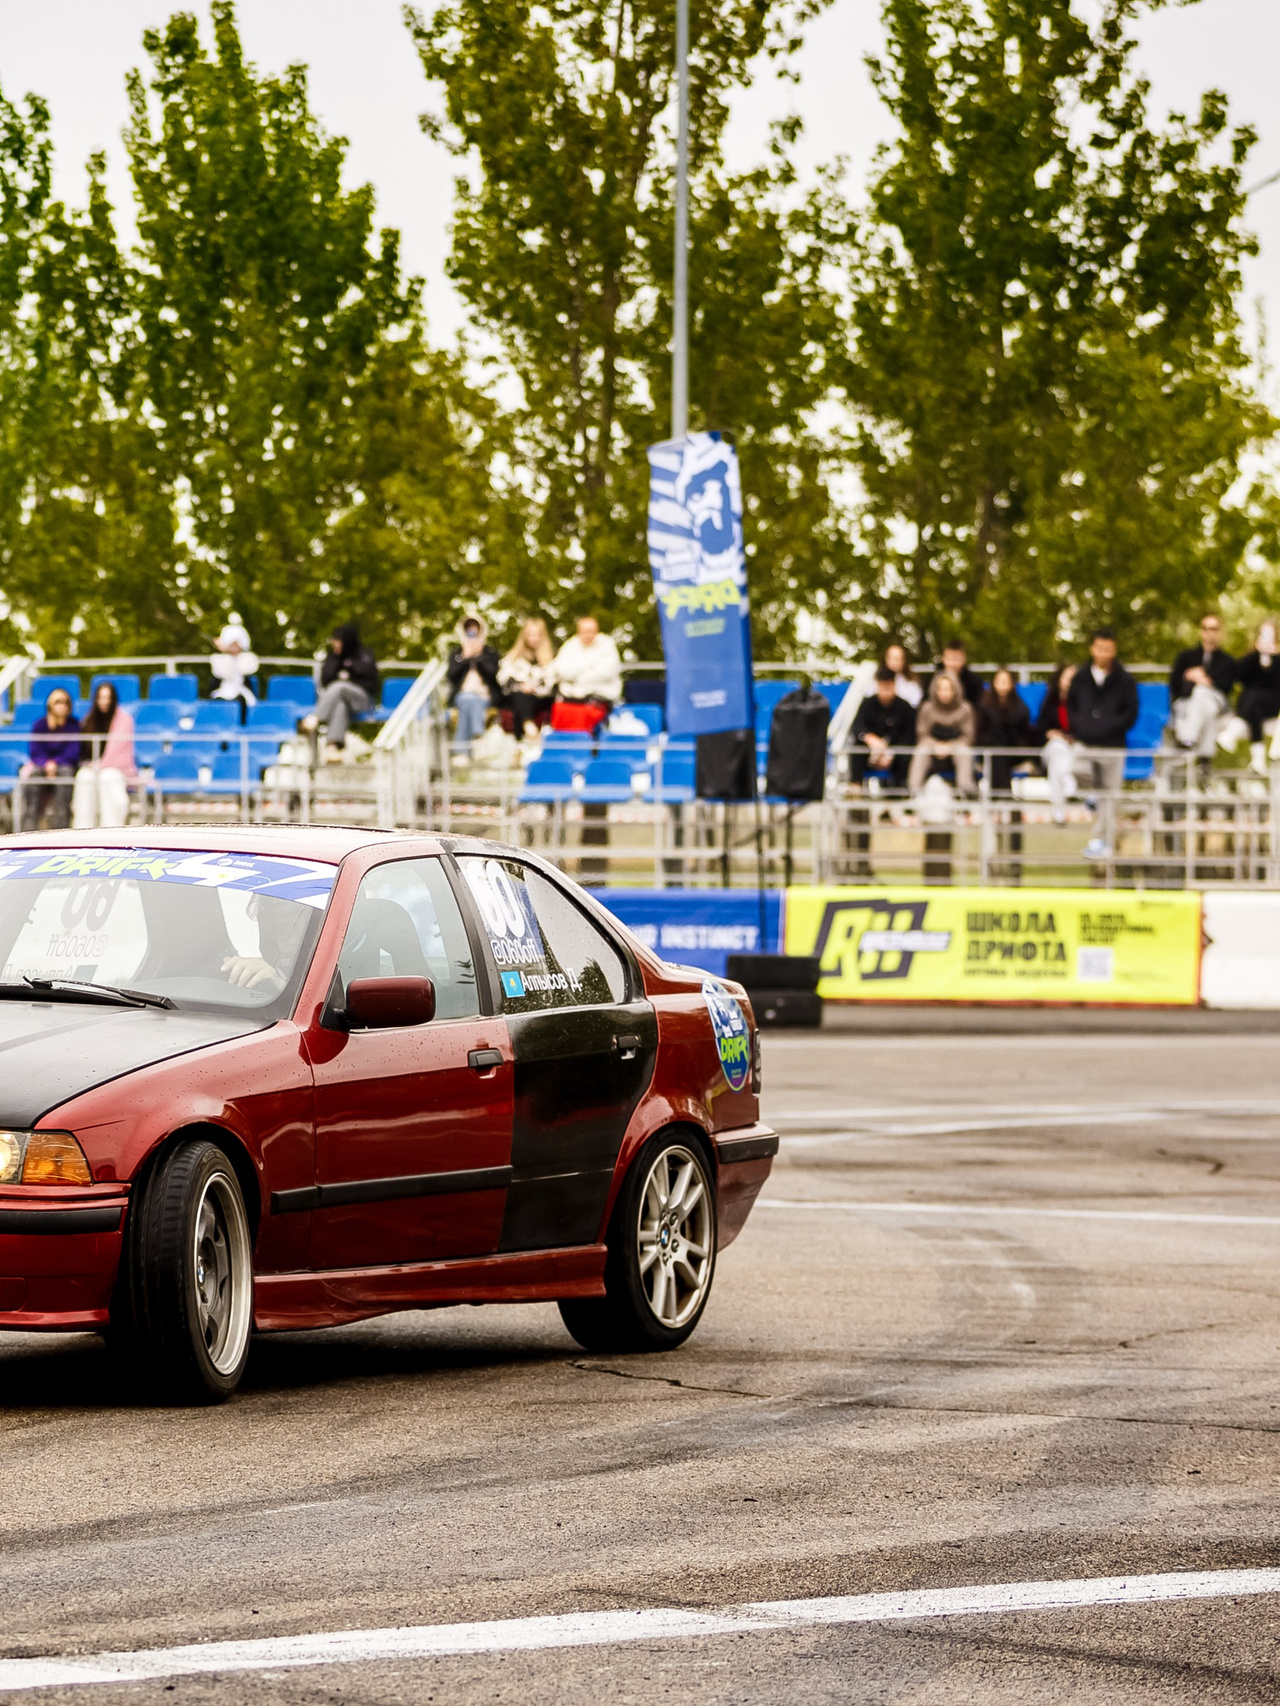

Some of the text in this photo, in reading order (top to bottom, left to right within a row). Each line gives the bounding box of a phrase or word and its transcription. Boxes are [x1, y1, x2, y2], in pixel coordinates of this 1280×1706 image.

[466, 860, 526, 938] 60
[967, 912, 1056, 932] ШКОЛА
[660, 924, 759, 949] INSTINCT
[491, 938, 539, 964] @060off
[967, 940, 1066, 961] ДРИФТА
